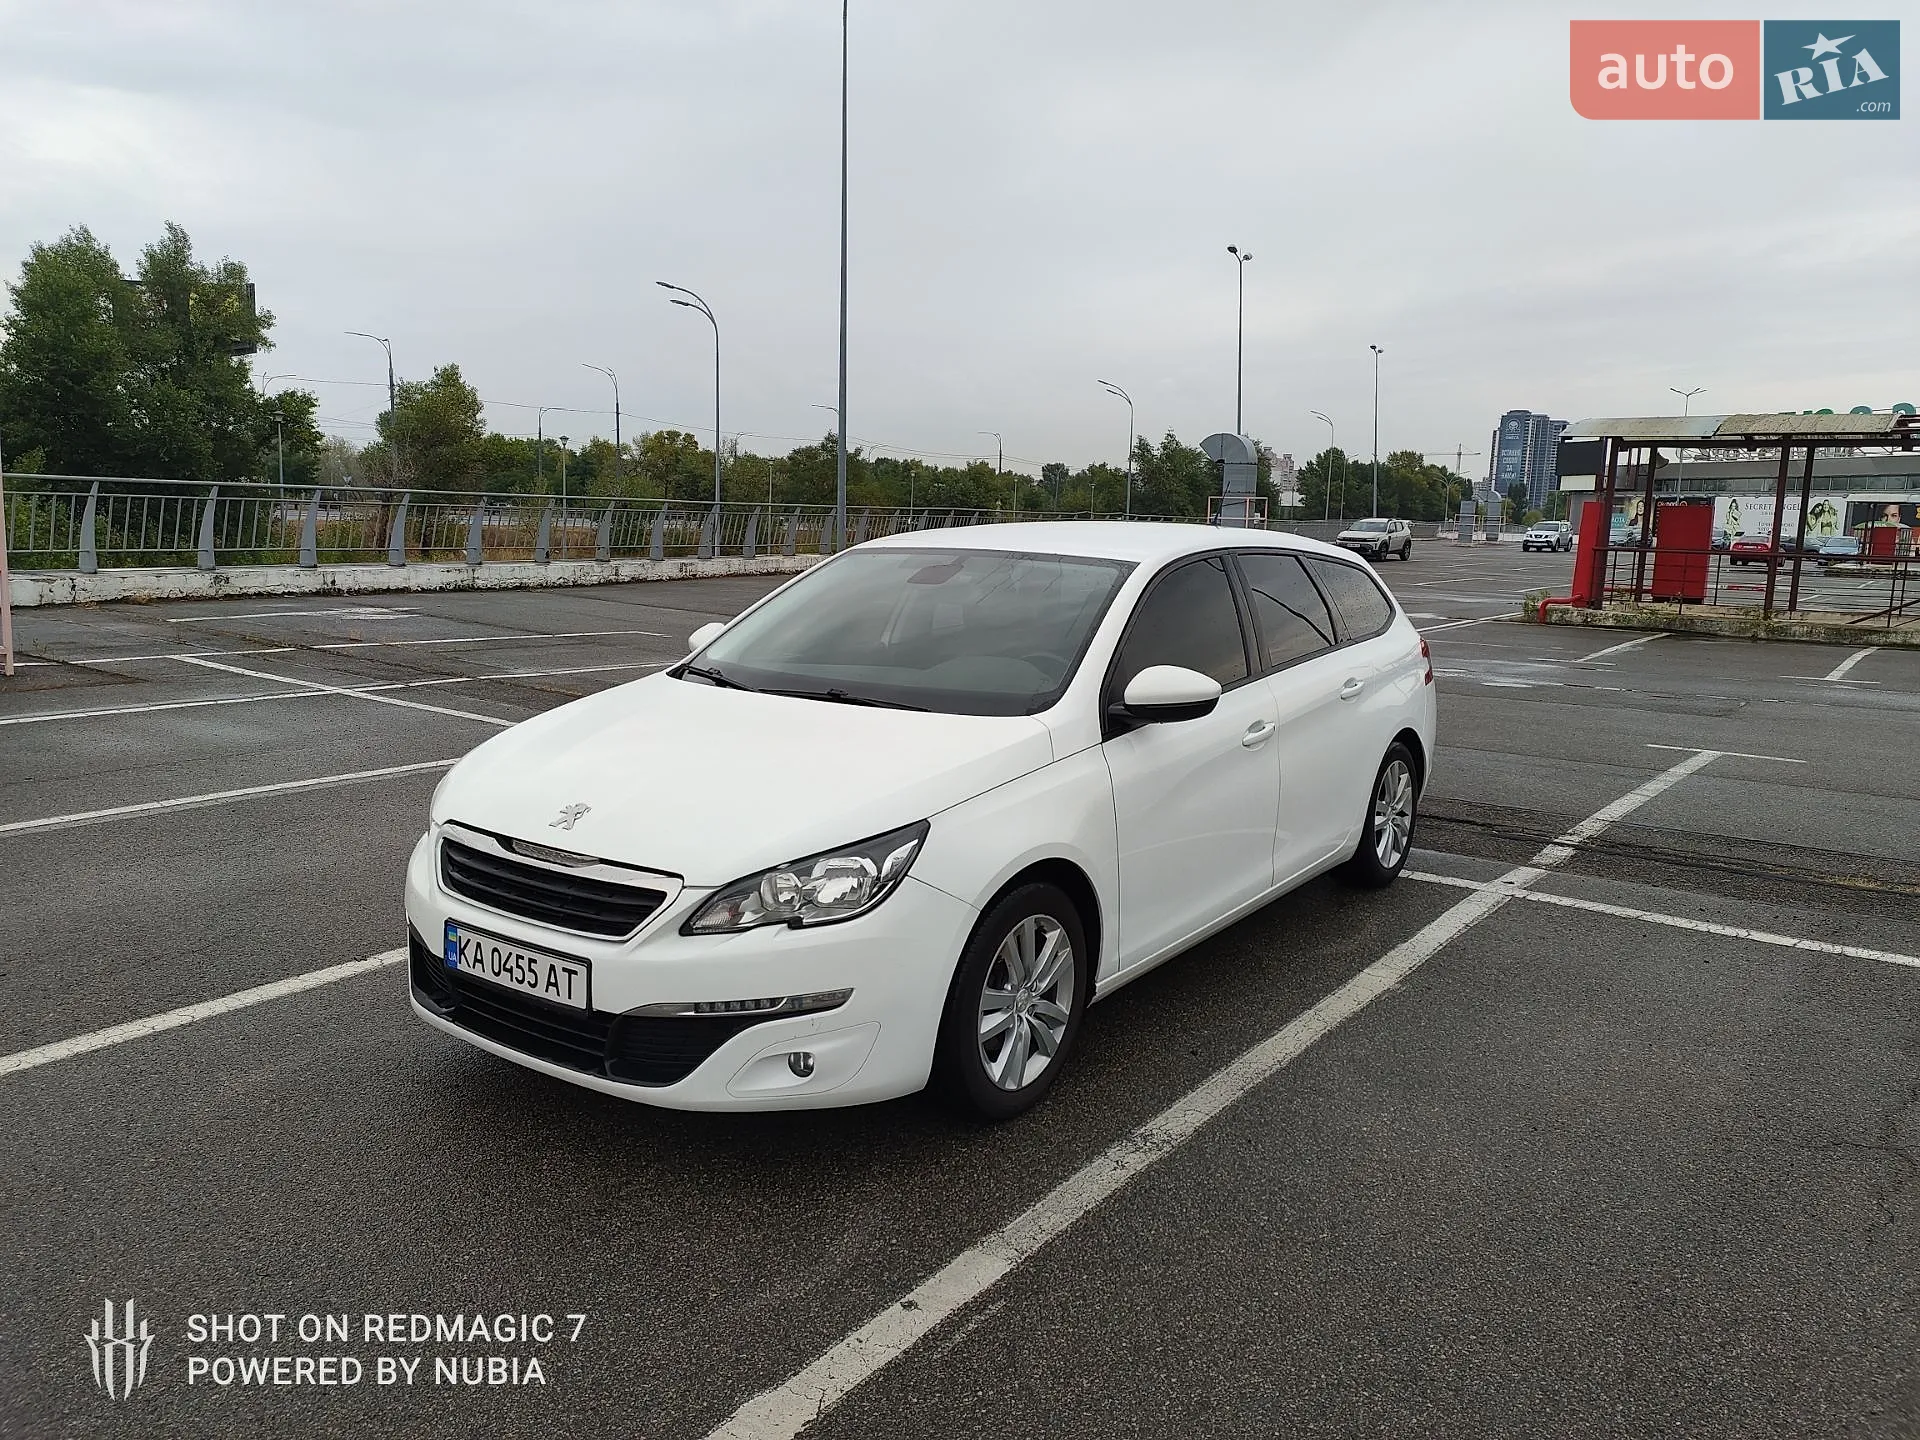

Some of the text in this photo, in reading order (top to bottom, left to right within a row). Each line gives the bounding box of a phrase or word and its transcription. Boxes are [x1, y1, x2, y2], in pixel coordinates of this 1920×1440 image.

[1744, 503, 1773, 511] SECRET
[448, 951, 457, 961] UA
[458, 935, 579, 1000] KA 0455 AT
